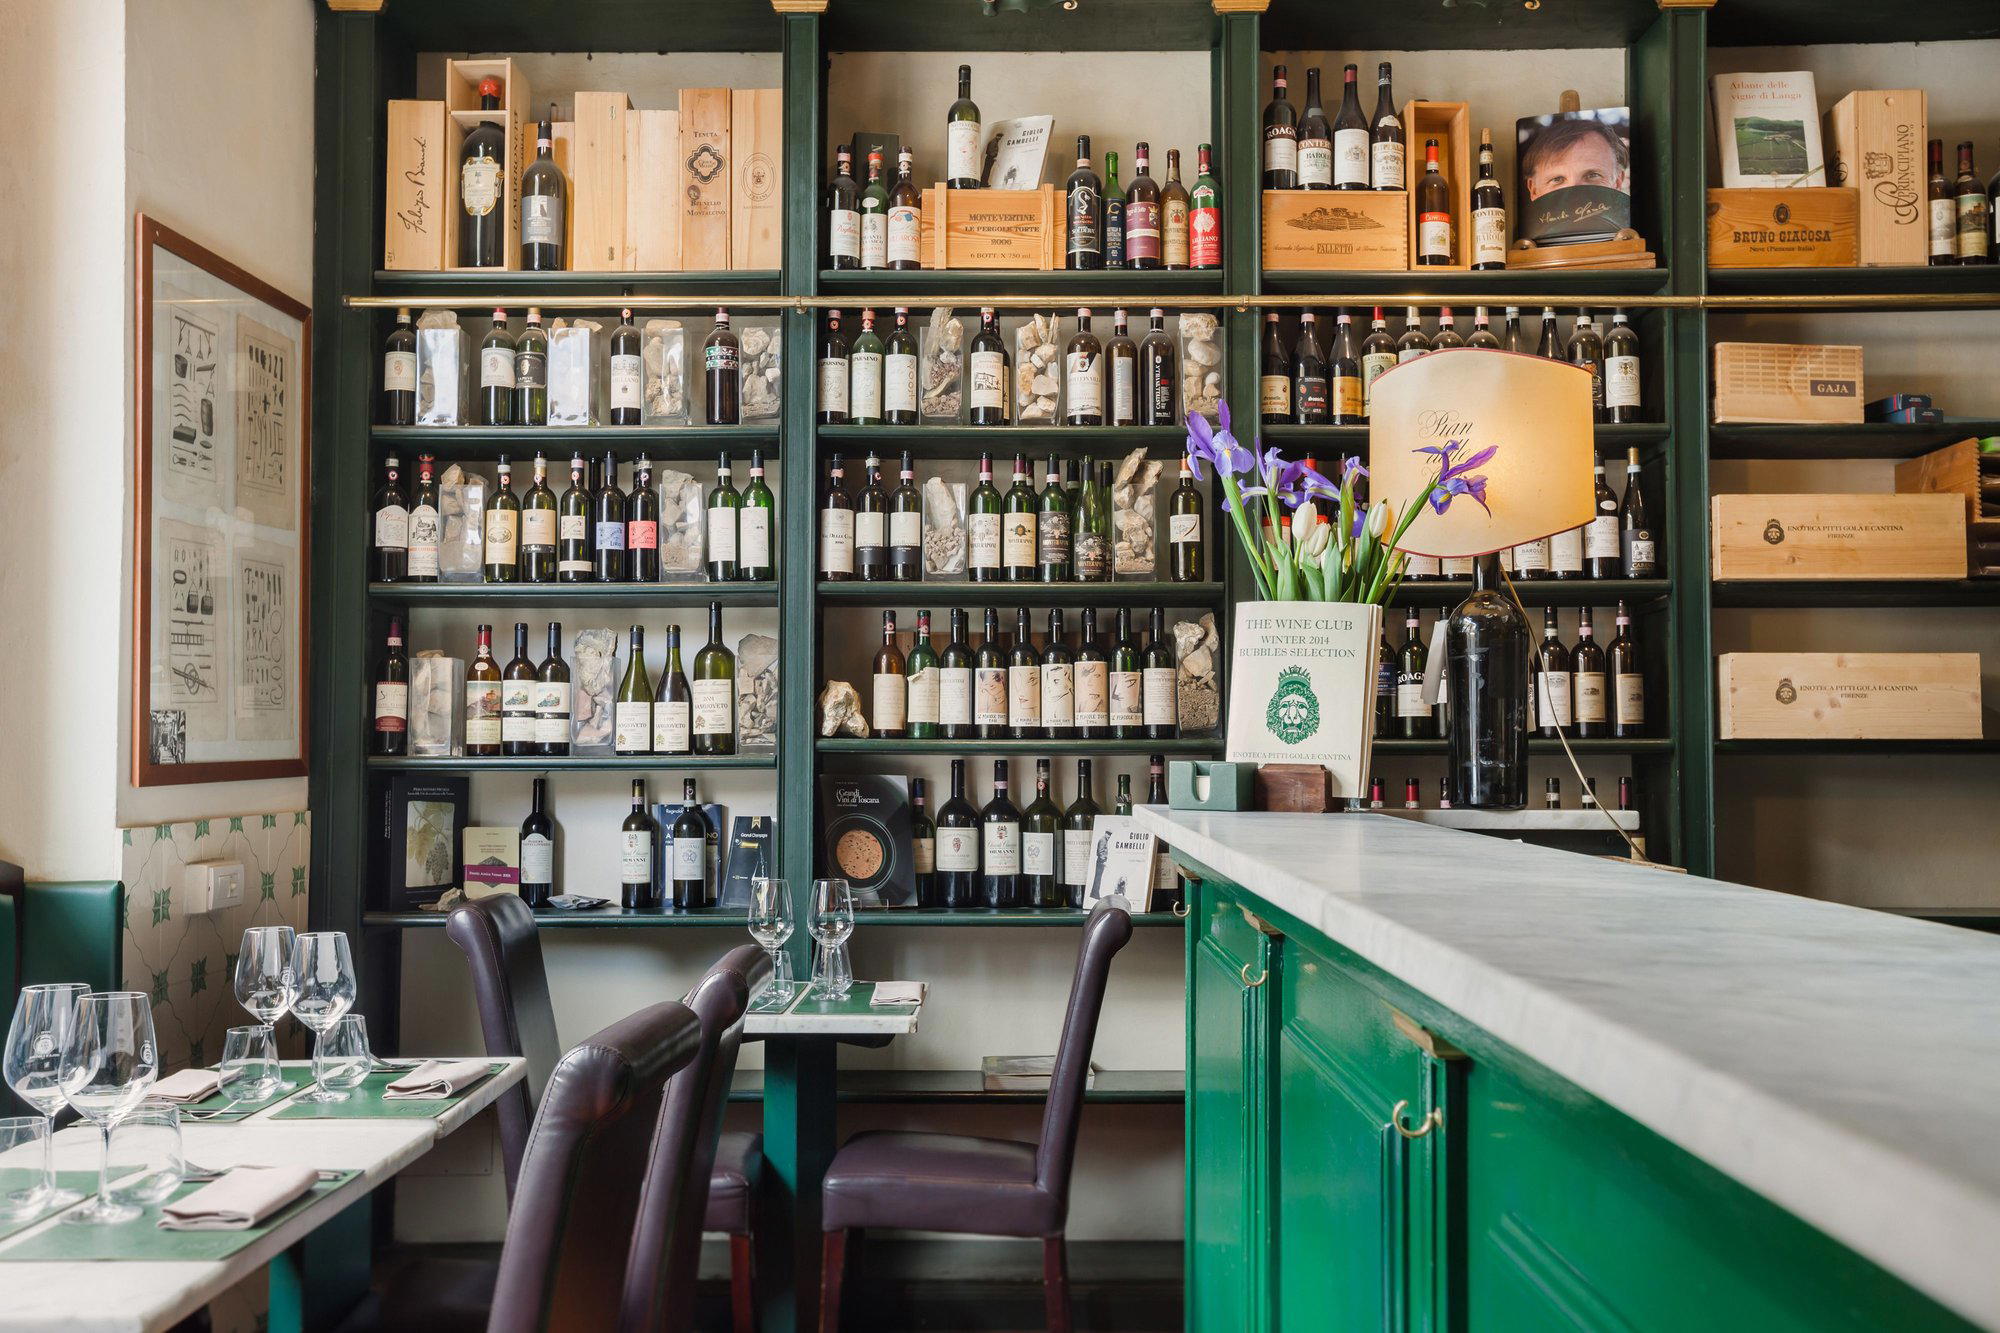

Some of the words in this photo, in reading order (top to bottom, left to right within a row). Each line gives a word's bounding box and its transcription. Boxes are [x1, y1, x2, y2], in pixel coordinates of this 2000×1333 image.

[1730, 81, 1762, 89] Atlante
[1767, 81, 1789, 89] delle
[1730, 93, 1757, 101] vigne
[1772, 92, 1801, 101] Langa
[1267, 127, 1296, 139] ROAGN
[1896, 124, 1909, 198] PRINCIPIANO
[687, 209, 726, 217] MONTALCINO
[1733, 231, 1775, 243] BRUNO
[1779, 230, 1832, 242] GIACOSA
[1316, 243, 1353, 254] FALLETTO
[1817, 383, 1849, 393] GAJA
[1418, 409, 1473, 439] Pian
[1246, 619, 1272, 630] THE
[1275, 619, 1312, 630] WINE
[1315, 619, 1353, 631] CLUB
[1261, 636, 1306, 645] WINTER
[1309, 636, 1330, 645] 2014
[1239, 648, 1288, 657] BUBBLES
[1289, 648, 1356, 658] SELECTION
[839, 789, 860, 799] Grandi
[1129, 831, 1149, 840] GIULIO
[1115, 841, 1145, 850] GAMBELLI
